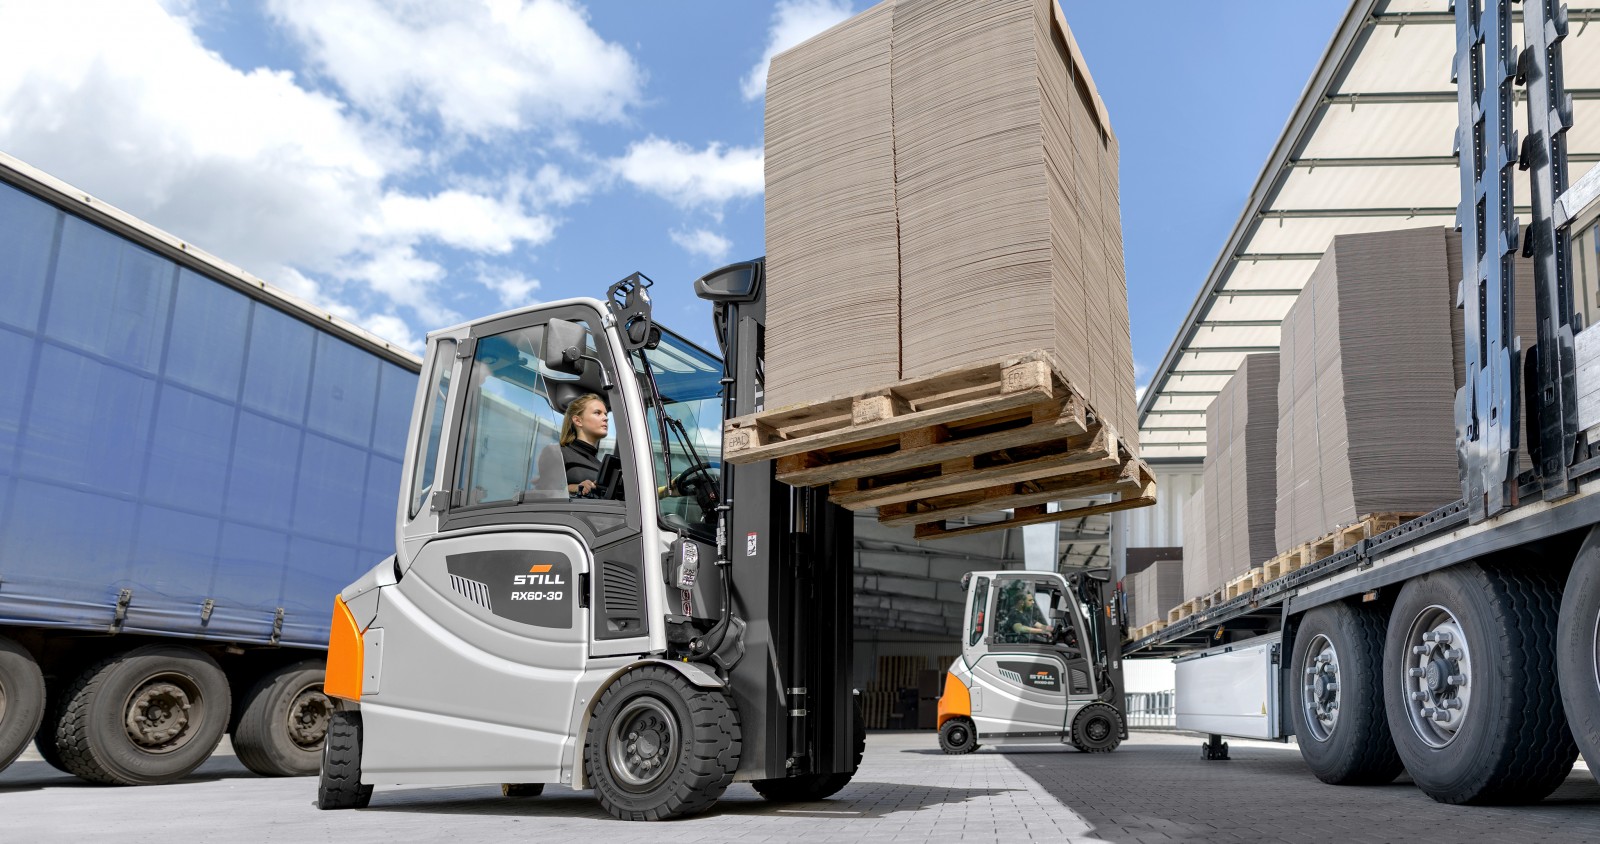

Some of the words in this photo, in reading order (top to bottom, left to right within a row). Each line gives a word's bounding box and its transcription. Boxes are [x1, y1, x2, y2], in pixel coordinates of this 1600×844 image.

[513, 574, 565, 585] STILL
[510, 591, 563, 601] RX60-30
[1109, 596, 1117, 626] STILL
